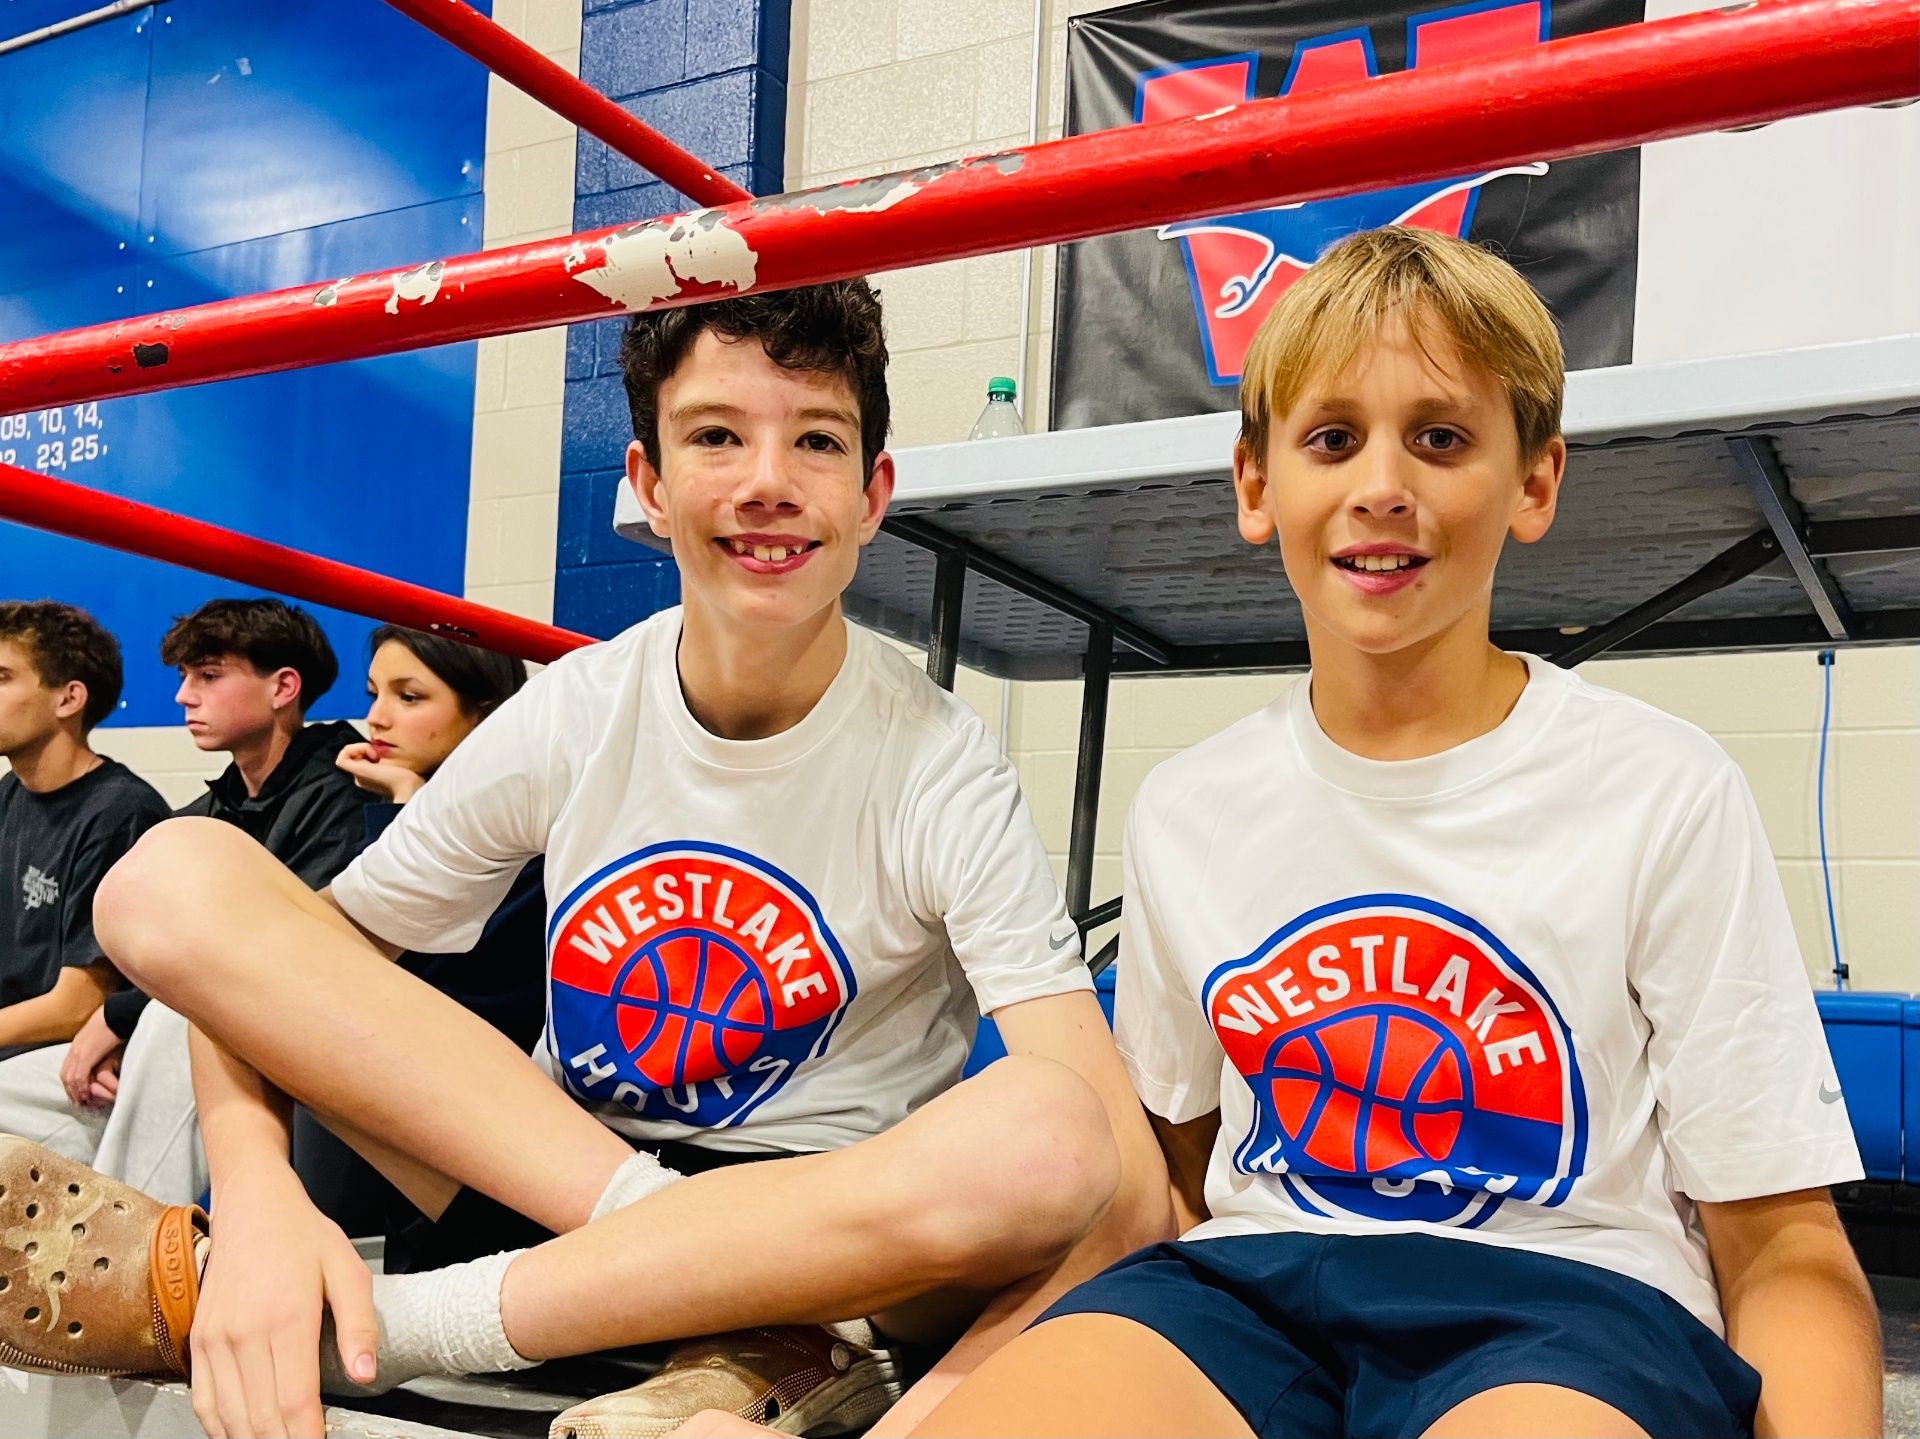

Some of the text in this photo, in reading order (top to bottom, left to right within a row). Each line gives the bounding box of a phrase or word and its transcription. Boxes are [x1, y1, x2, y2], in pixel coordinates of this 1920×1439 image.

[36, 441, 67, 471] 23,
[39, 407, 66, 436] 10,
[73, 401, 103, 430] 14,
[568, 872, 828, 1008] WESTLAKE
[1218, 934, 1547, 1077] WESTLAKE
